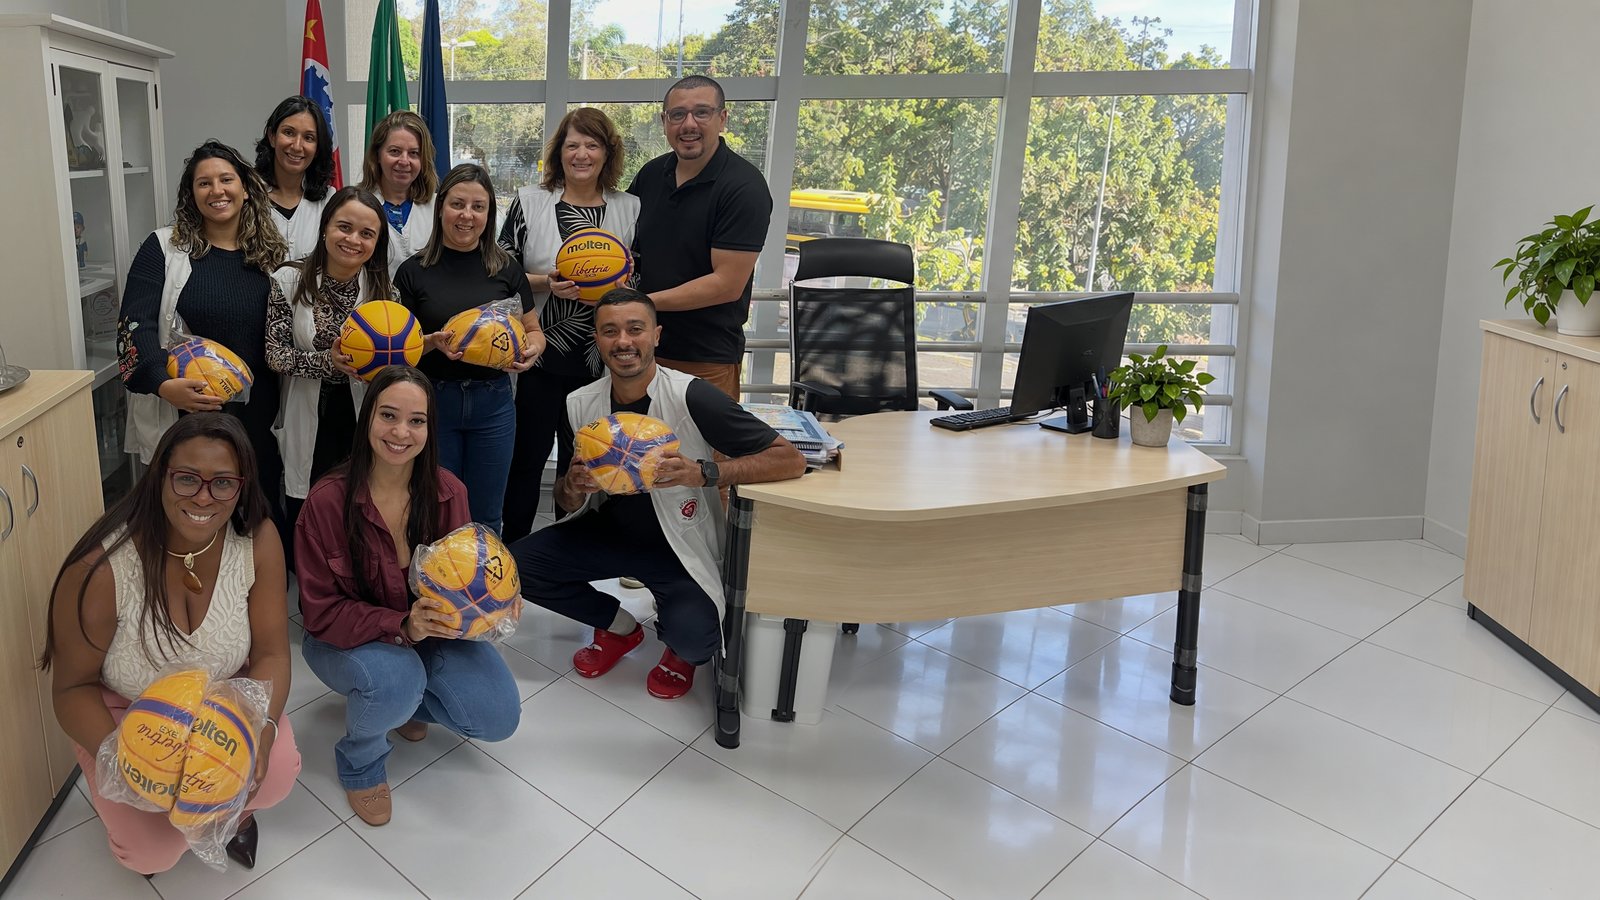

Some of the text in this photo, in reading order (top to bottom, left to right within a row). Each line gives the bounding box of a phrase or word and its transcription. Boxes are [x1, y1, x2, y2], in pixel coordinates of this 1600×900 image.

[567, 240, 611, 254] molten
[569, 260, 611, 277] Libertria
[191, 716, 238, 757] olten
[182, 771, 216, 794] rtria
